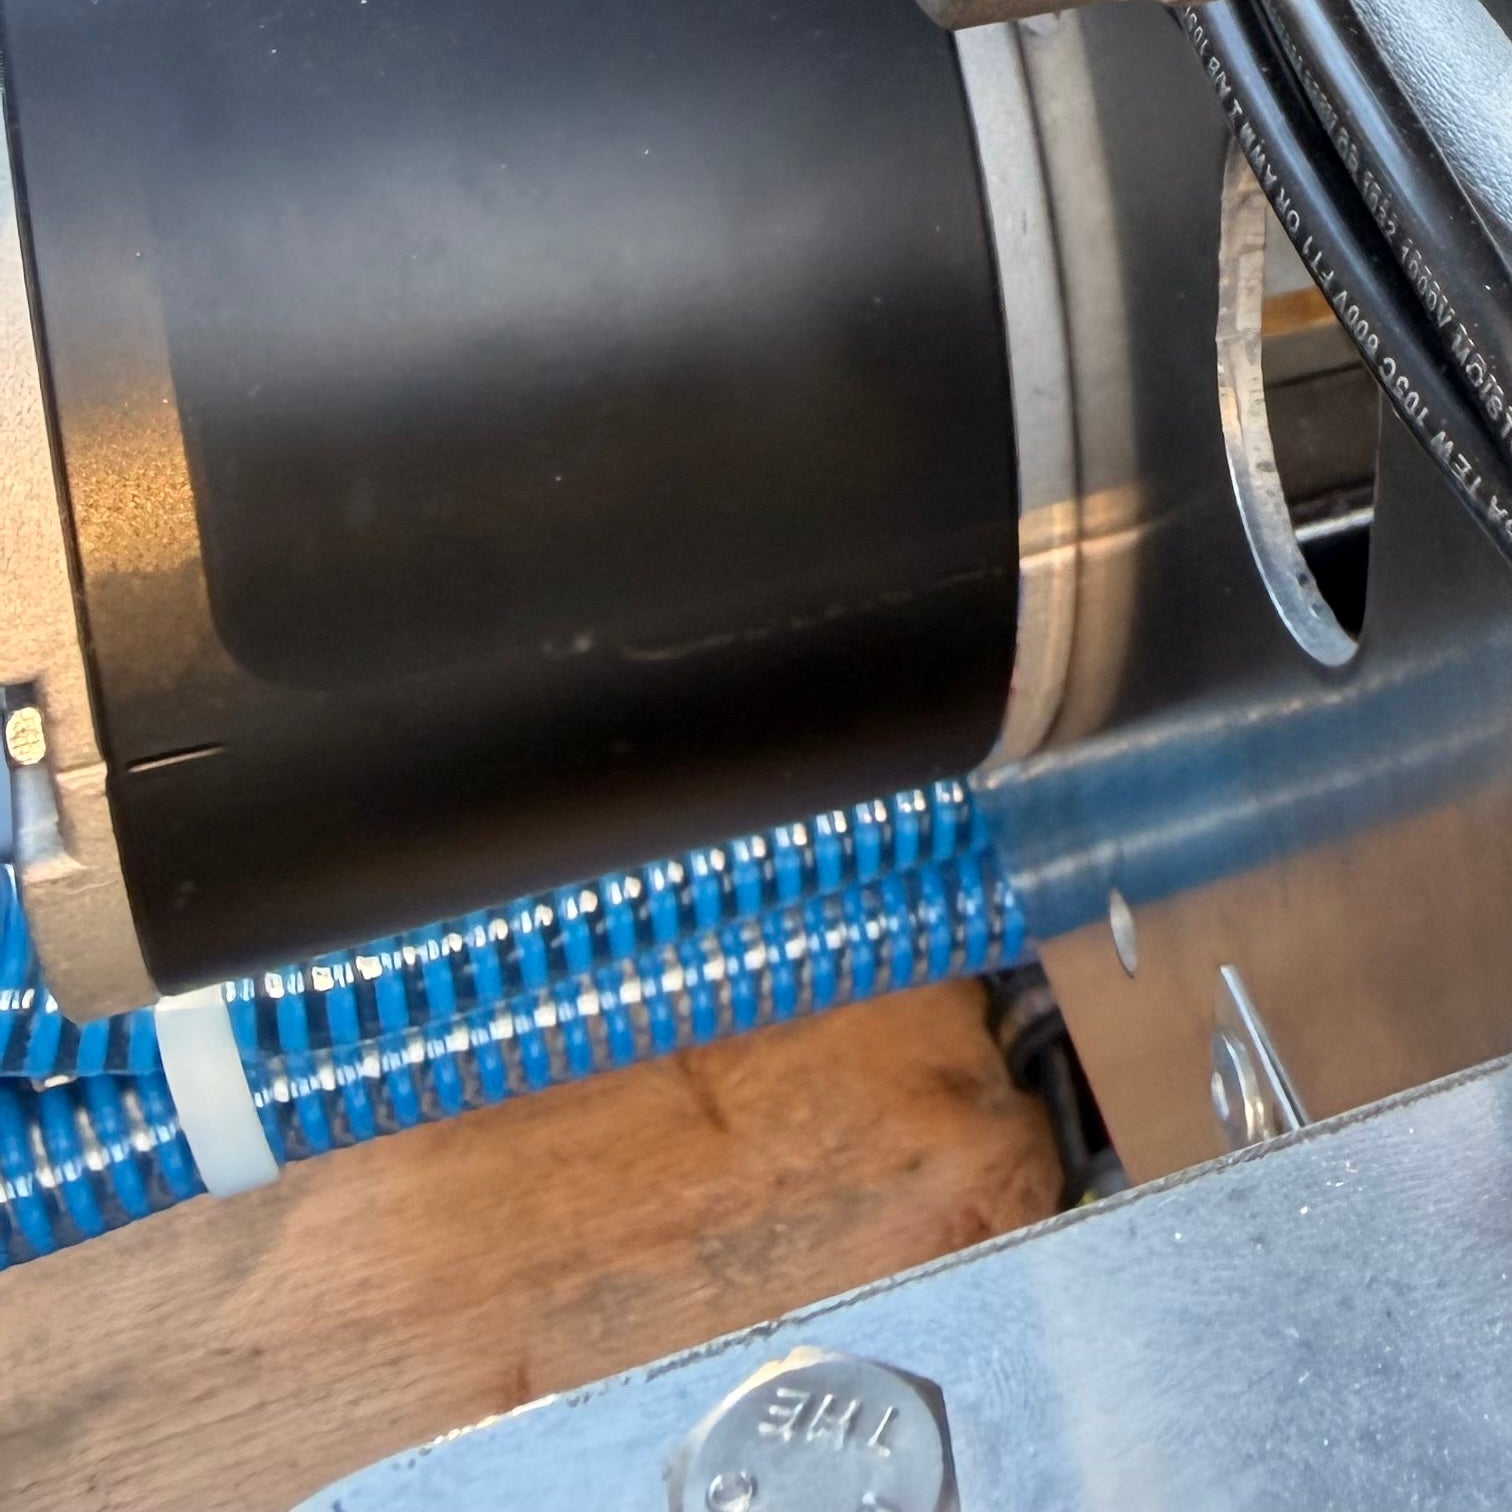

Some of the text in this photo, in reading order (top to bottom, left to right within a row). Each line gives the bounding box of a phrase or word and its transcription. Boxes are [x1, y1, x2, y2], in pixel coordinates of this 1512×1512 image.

[1239, 120, 1279, 187] AWM
[1274, 187, 1301, 234] OR
[1331, 290, 1380, 361] 600V
[1376, 356, 1430, 427] 105C
[1429, 430, 1483, 500] TEW
